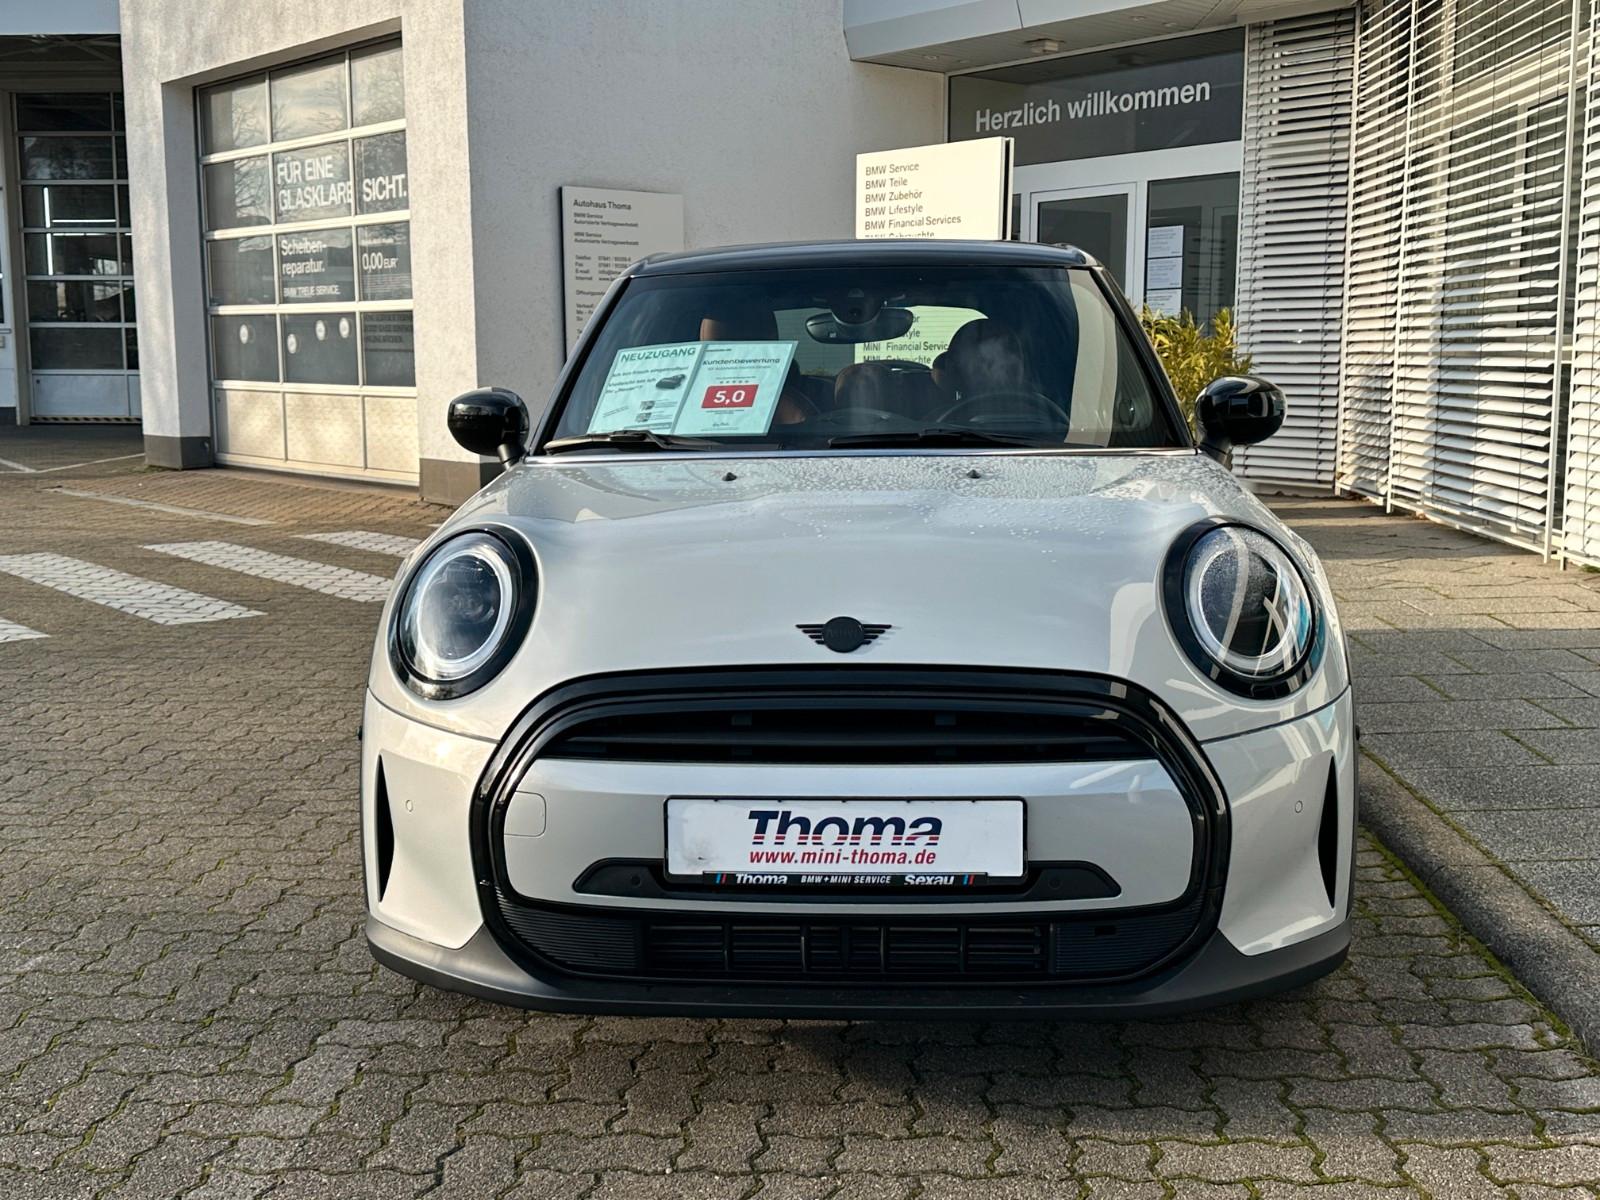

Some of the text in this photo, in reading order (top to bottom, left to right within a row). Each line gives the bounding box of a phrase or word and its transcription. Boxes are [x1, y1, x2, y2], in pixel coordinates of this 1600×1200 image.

[976, 81, 1210, 132] Herzlich willkommen
[277, 155, 334, 185] FÜR EINE
[865, 163, 920, 176] BMW Service
[865, 177, 908, 190] BMW Teile
[278, 174, 407, 211] GLASKLARE SICHT.
[865, 189, 923, 203] BMW Zubehör
[573, 200, 632, 210] Autohaus Thoma
[864, 203, 924, 217] BMW Lifestyle
[864, 216, 962, 231] BMW Financial Services
[281, 237, 328, 256] Scheiben-
[281, 258, 326, 279] reparatur.
[361, 252, 384, 273] 0,00
[863, 341, 948, 352] MINI Financial Servic
[620, 347, 697, 363] NEUZUGANG
[713, 390, 746, 405] 5,0
[748, 810, 943, 846] Thoma
[749, 849, 937, 865] www.mini-thoma.de
[736, 874, 788, 884] Thoma
[853, 875, 892, 884] SERVICE
[903, 874, 955, 885] Sexau
